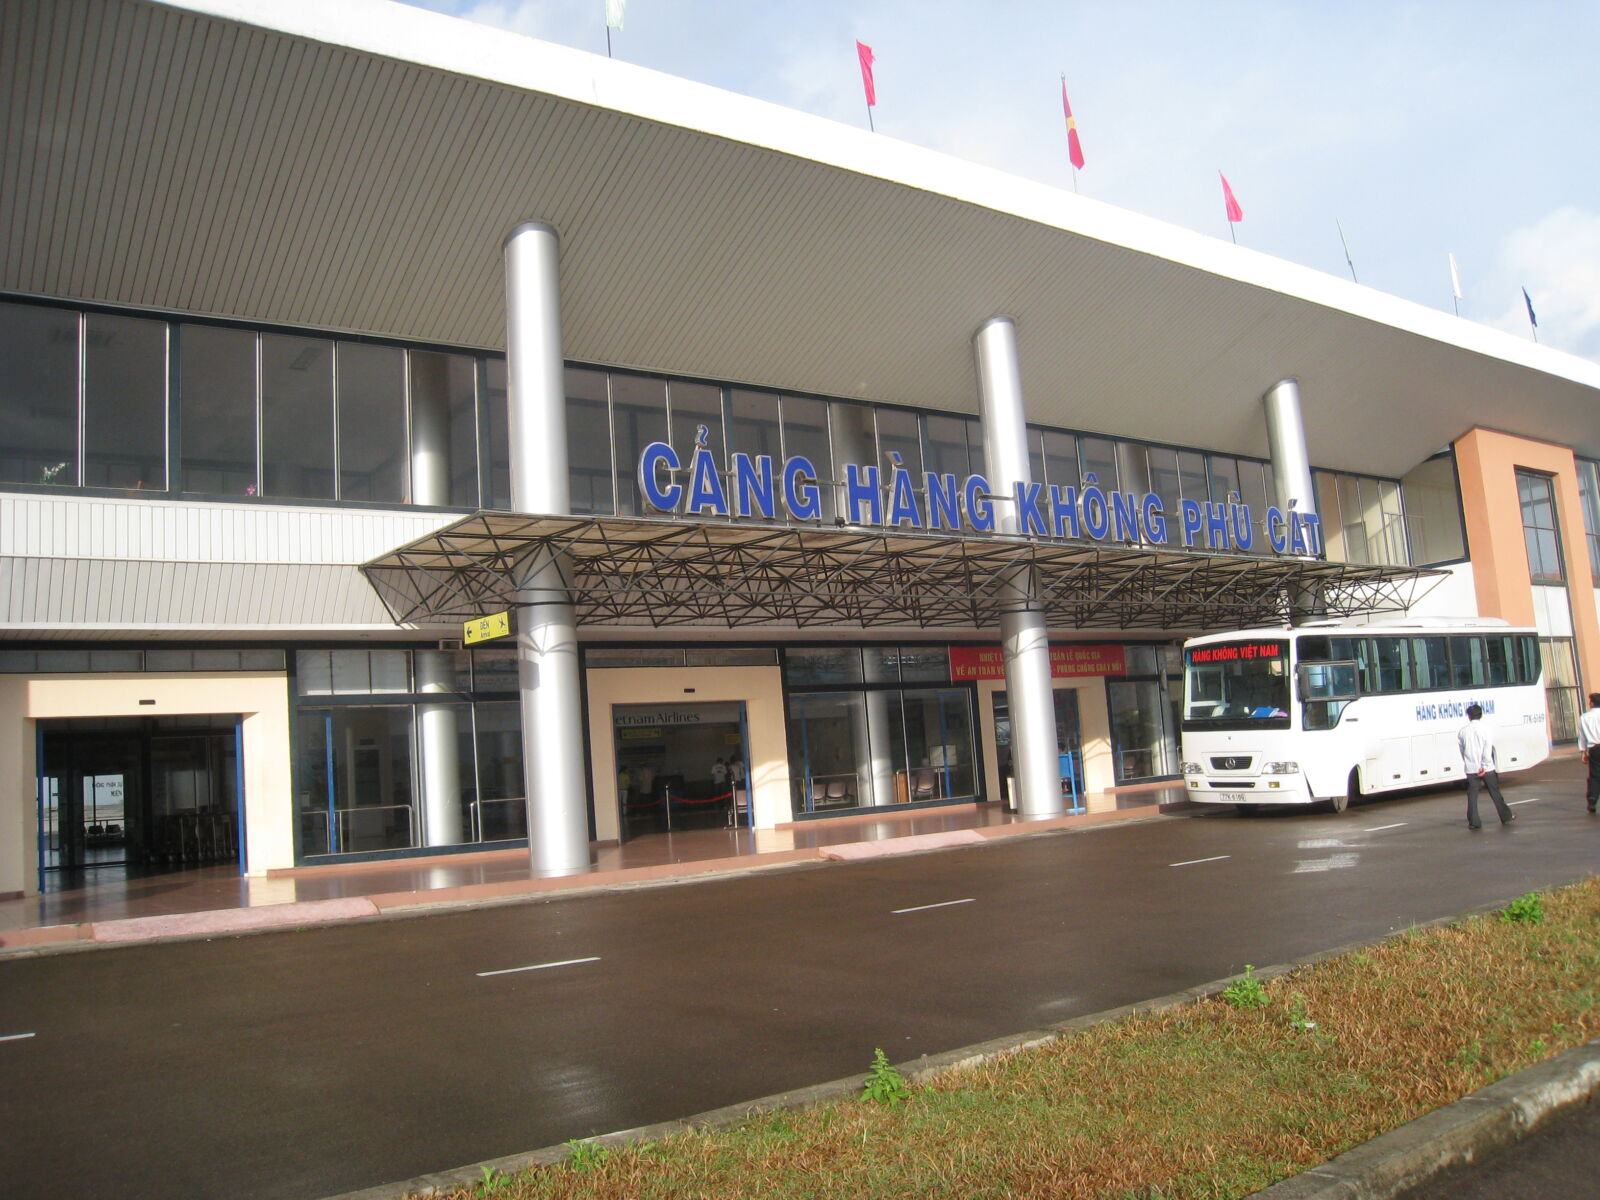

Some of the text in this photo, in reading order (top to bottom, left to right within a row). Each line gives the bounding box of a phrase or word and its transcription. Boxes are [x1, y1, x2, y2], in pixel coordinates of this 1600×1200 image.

[638, 424, 1321, 555] CẢNG HÀNG KHÔNG PHÙ CÁT
[1193, 644, 1279, 662] HÀNG KHÔNG VIỆT NAM
[616, 711, 700, 725] etnam Airlines
[1416, 701, 1437, 721] HÀNG
[1438, 699, 1463, 718] KHÔNG
[1480, 700, 1495, 714] NAM
